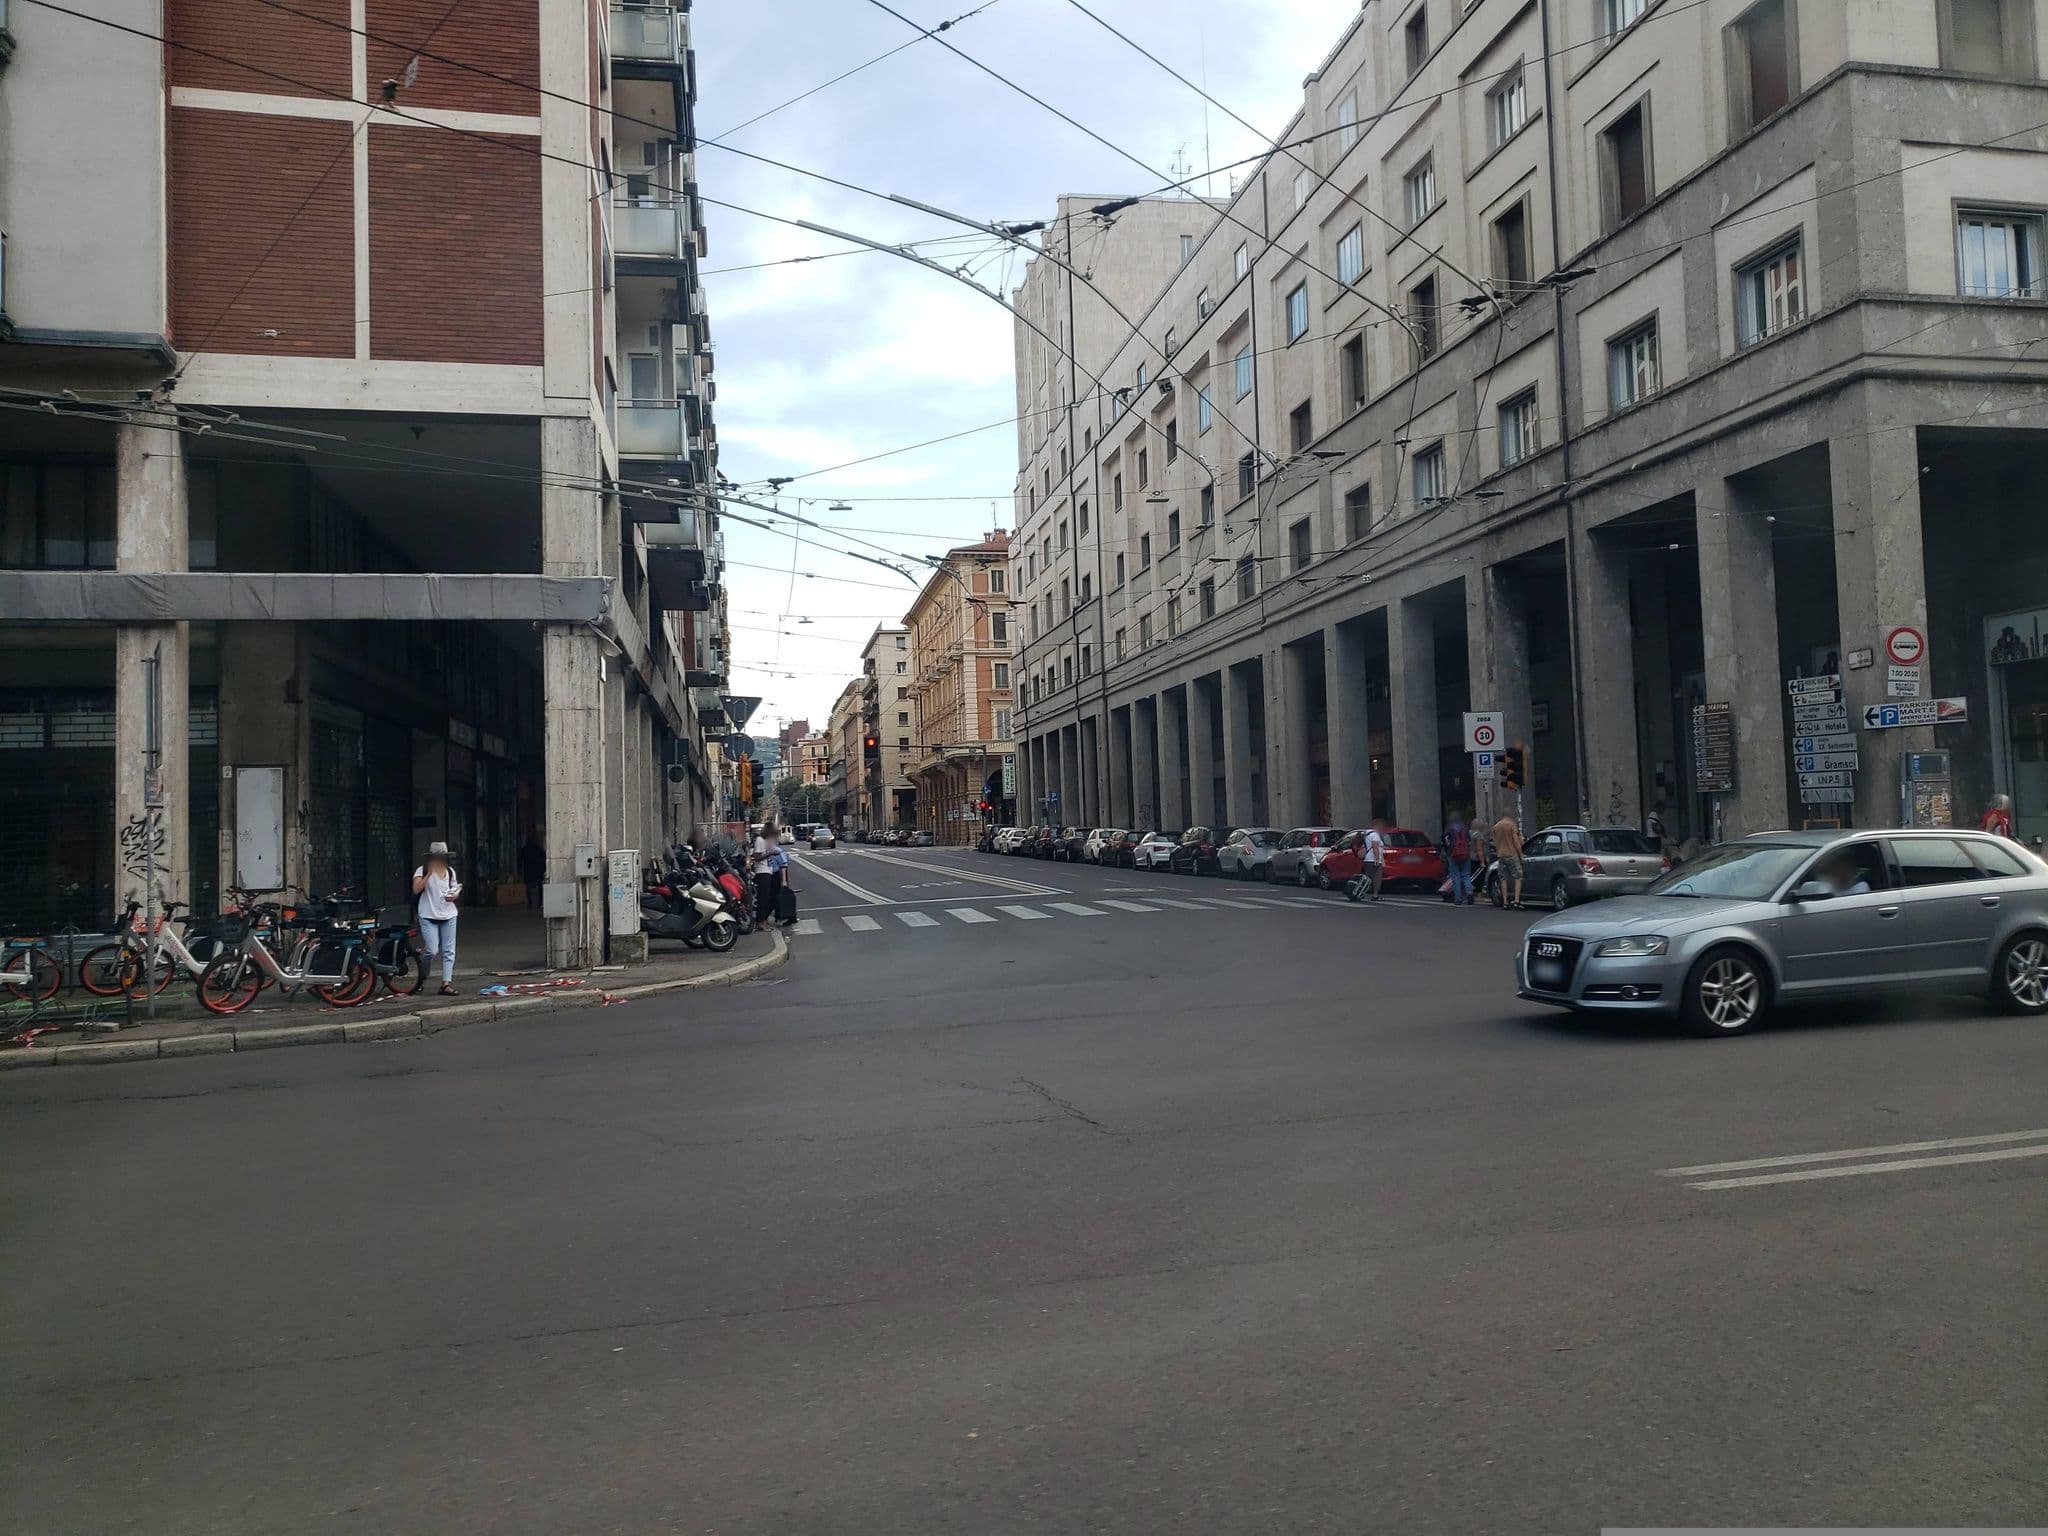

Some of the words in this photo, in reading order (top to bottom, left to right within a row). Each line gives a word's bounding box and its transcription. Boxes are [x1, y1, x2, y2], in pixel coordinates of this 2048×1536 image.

[1899, 701, 1936, 709] PARKING
[1899, 707, 1936, 715] MARTE
[1825, 722, 1846, 731] Hotels
[1479, 731, 1490, 740] 30
[1825, 760, 1856, 769] Gramsci
